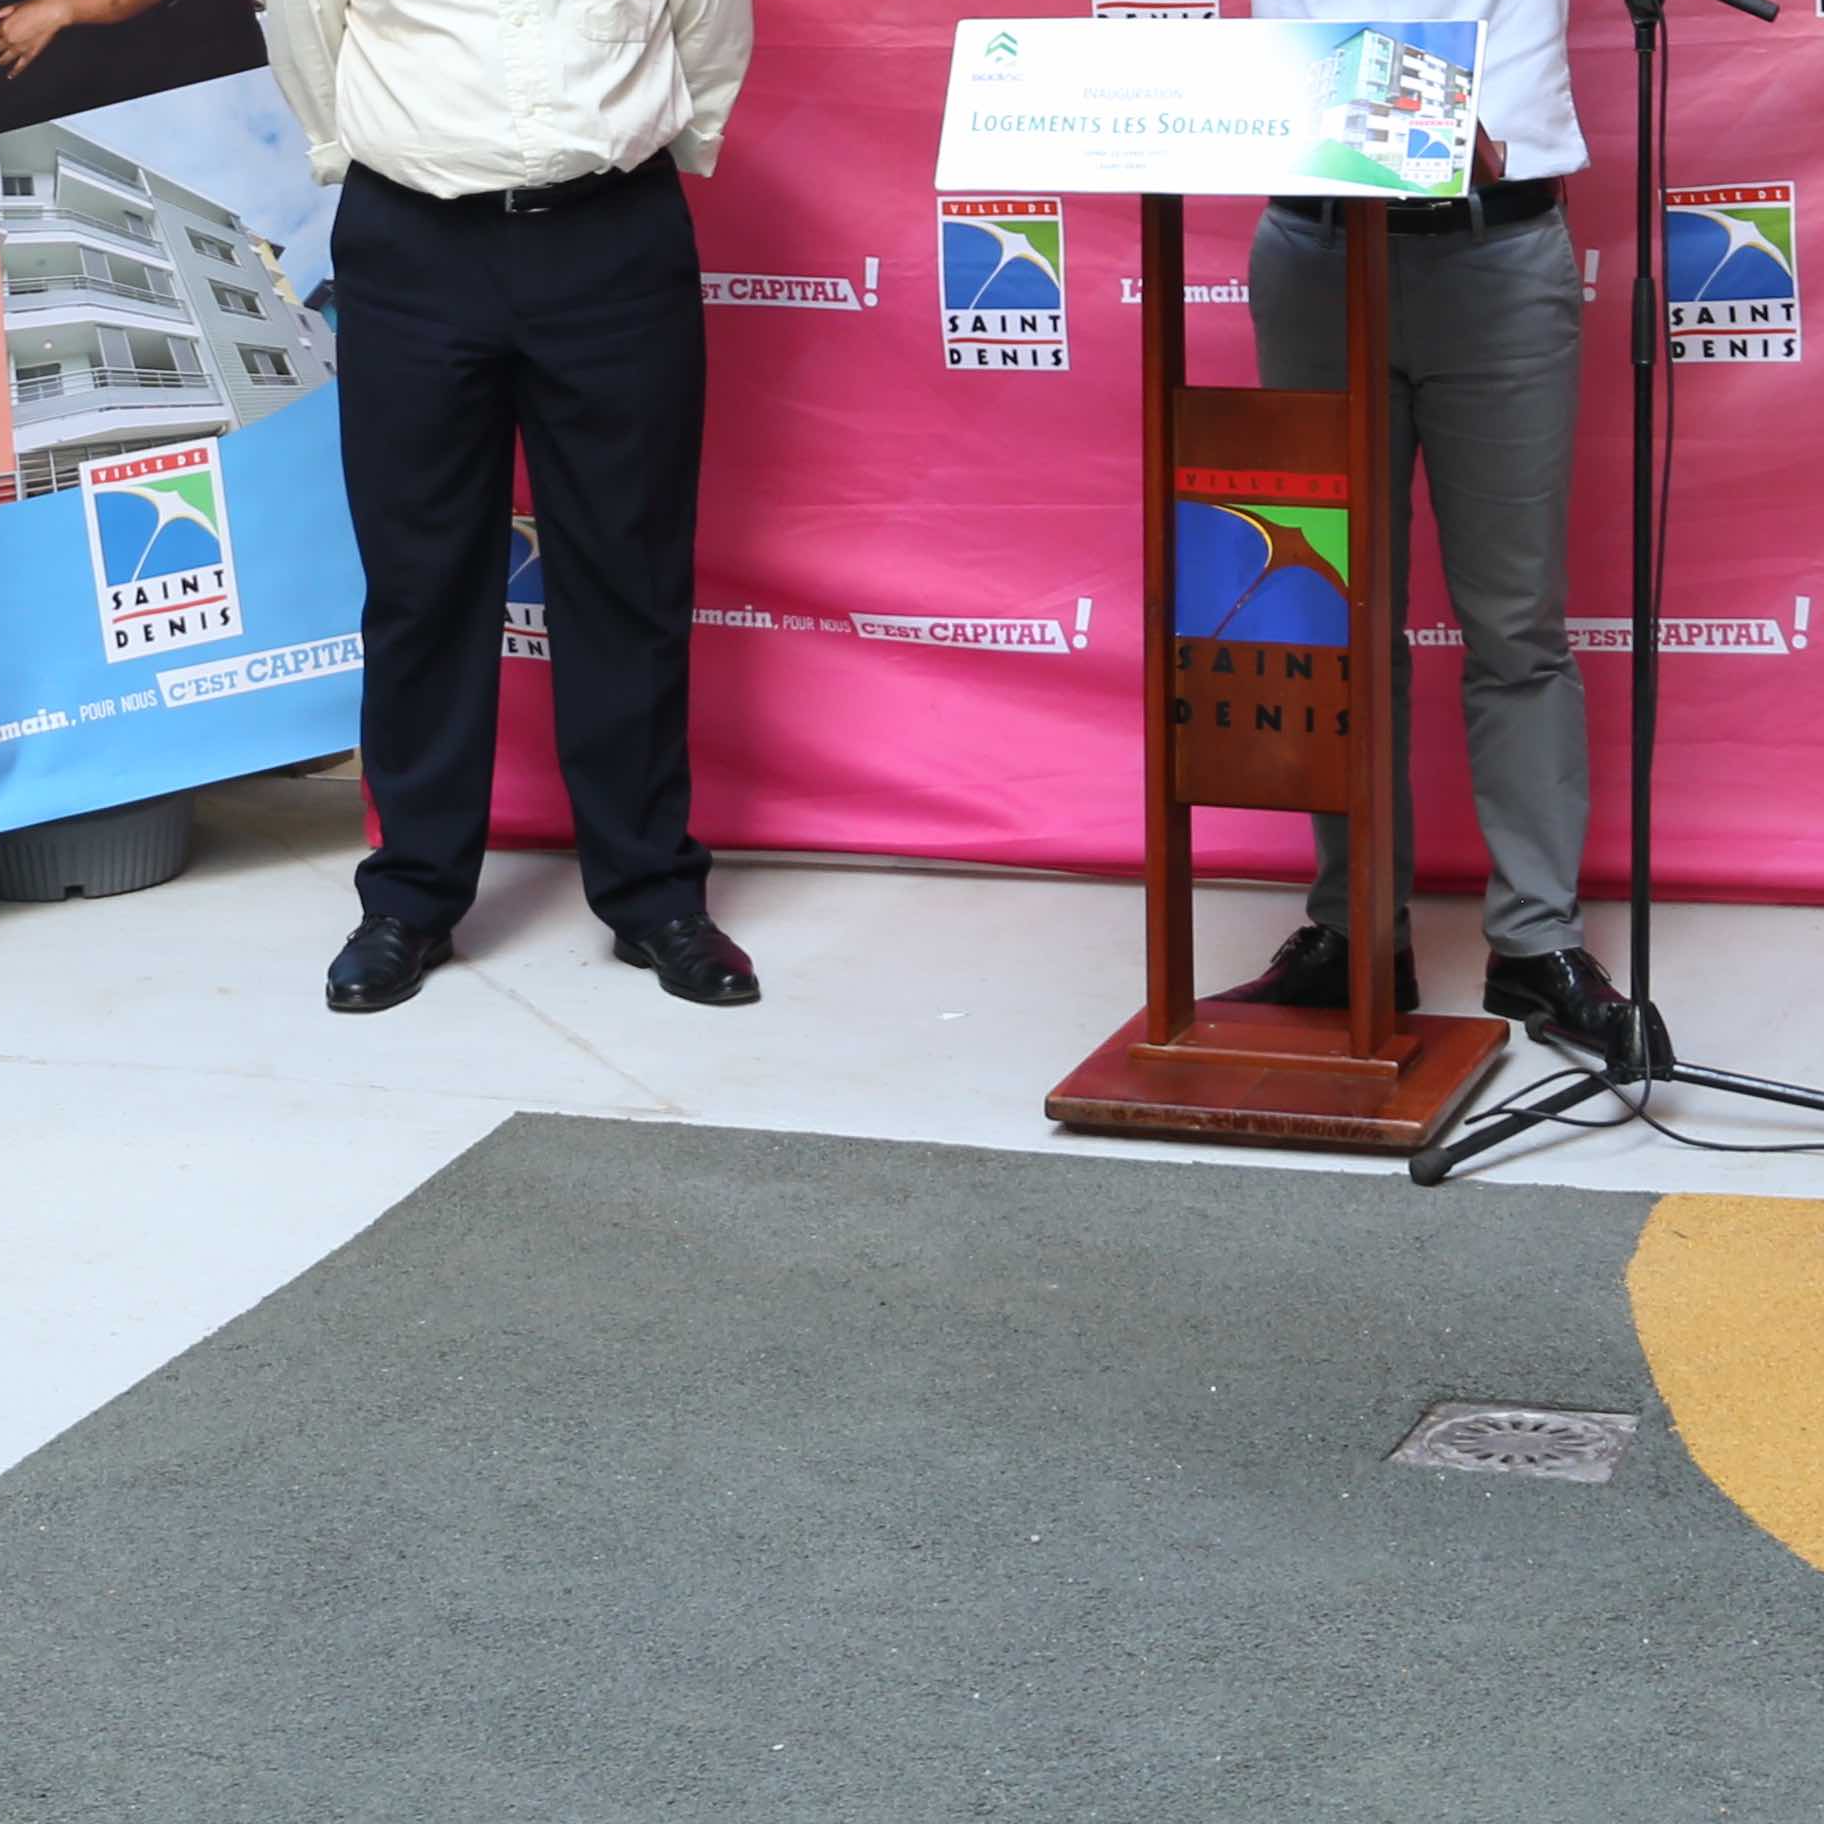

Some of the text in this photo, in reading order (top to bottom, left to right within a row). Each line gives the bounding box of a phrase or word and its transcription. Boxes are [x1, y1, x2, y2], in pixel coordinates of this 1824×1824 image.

[1758, 188, 1783, 200] DE
[949, 202, 1052, 214] VILLE DE
[729, 278, 848, 302] CAPITAL
[948, 314, 1061, 334] SAINT
[1670, 302, 1794, 327] SAINT
[950, 348, 1063, 366] DENIS
[1671, 338, 1795, 361] DENIS
[97, 450, 203, 483] VILLE DE
[1186, 474, 1283, 490] VILLE
[112, 569, 226, 610] SAINT
[115, 608, 232, 648] DENIS
[783, 614, 816, 632] POUR
[821, 617, 850, 633] NOUS
[860, 621, 924, 640] C'EST
[929, 622, 1056, 646] CAPITAL
[1176, 645, 1349, 681] SAINT
[80, 699, 116, 725] POUR
[121, 690, 158, 713] NOUS
[169, 670, 238, 702] C'EST
[245, 637, 364, 683] CAPITA
[1173, 698, 1349, 736] DENIS
